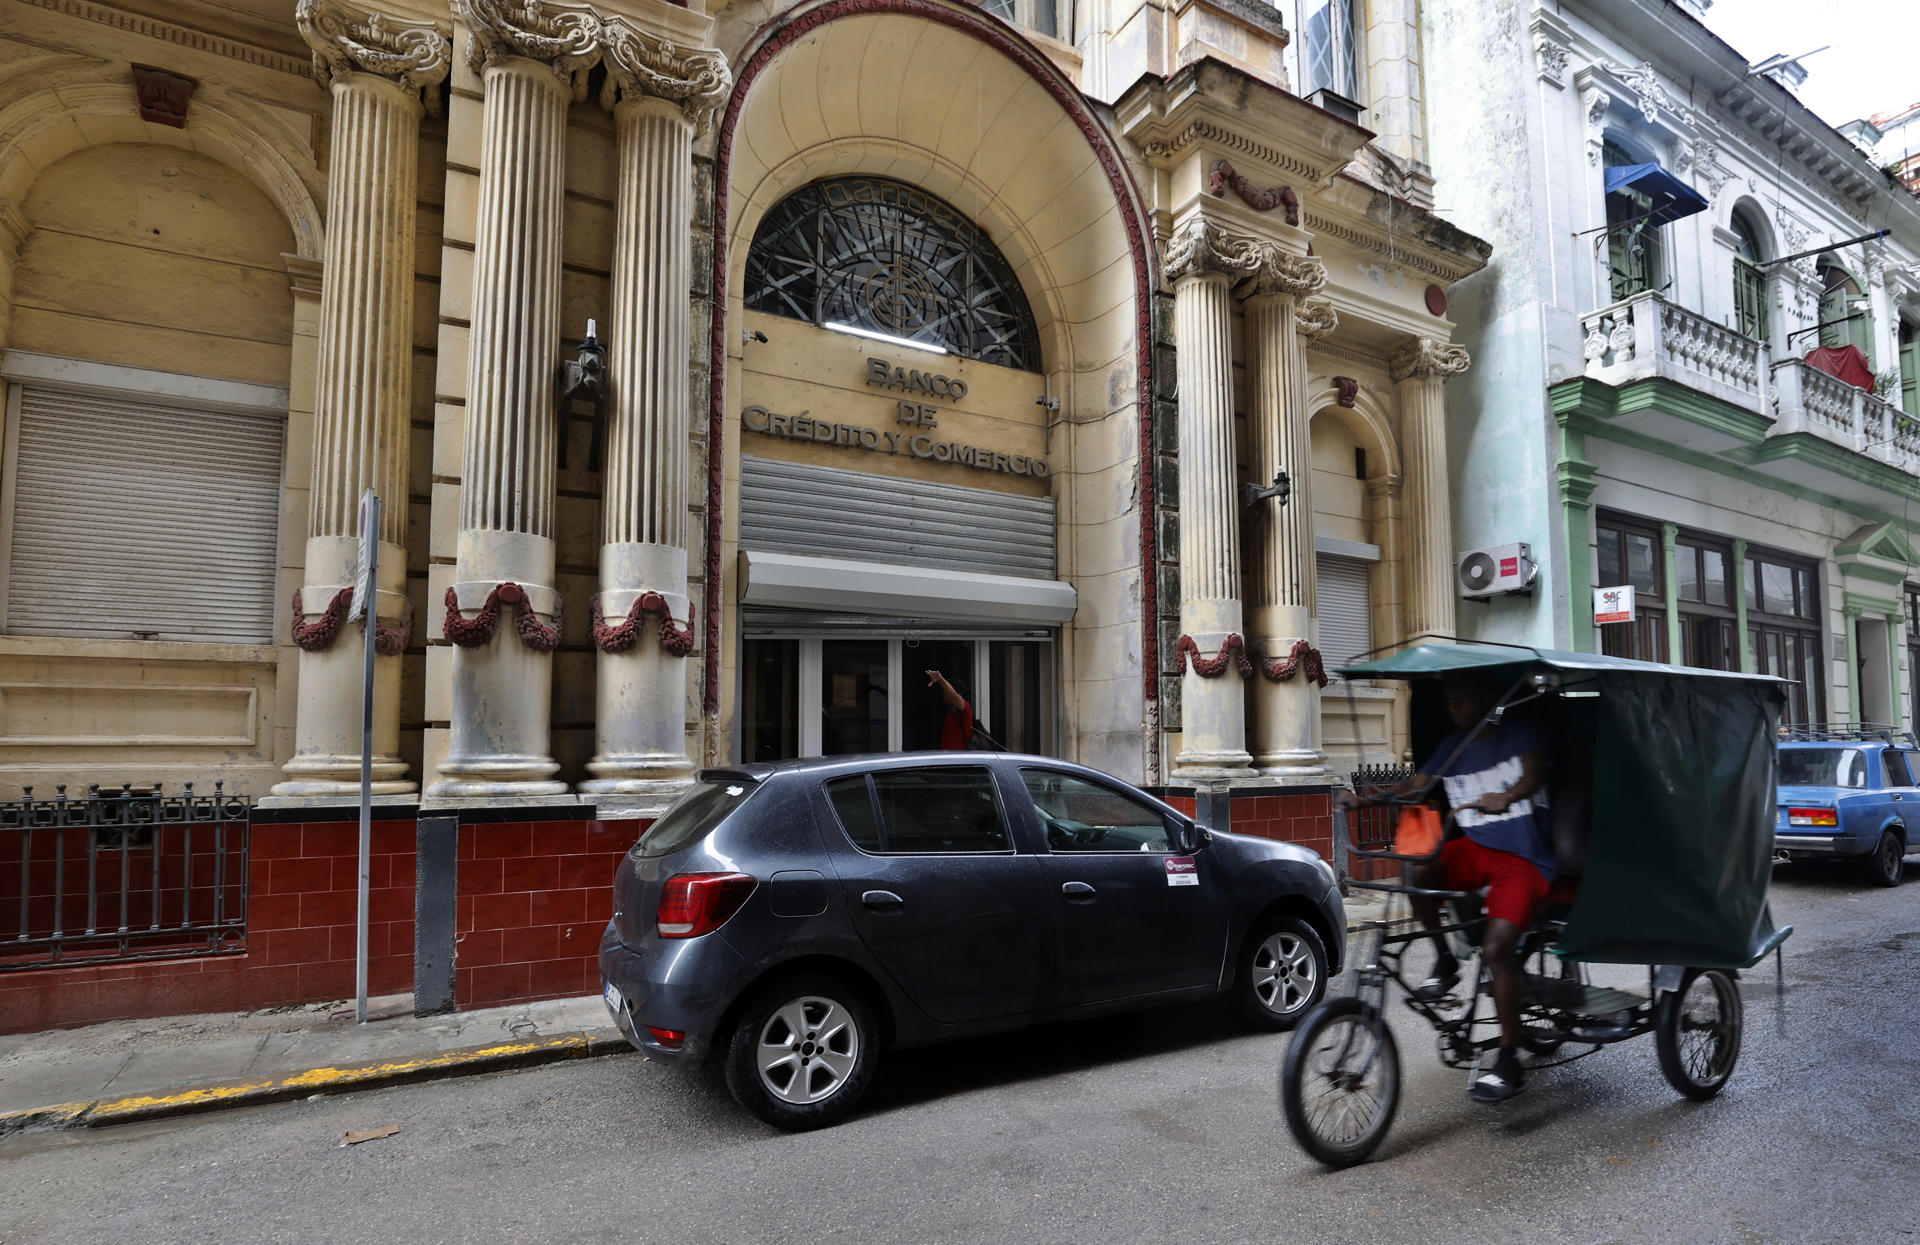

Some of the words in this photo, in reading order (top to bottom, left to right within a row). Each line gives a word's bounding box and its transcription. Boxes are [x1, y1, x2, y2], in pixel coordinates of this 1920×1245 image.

[866, 357, 968, 401] BANCO
[897, 401, 938, 429] DE
[741, 404, 881, 449] CRÉDITO
[884, 431, 906, 455] Y
[909, 434, 1049, 478] COMERCIO
